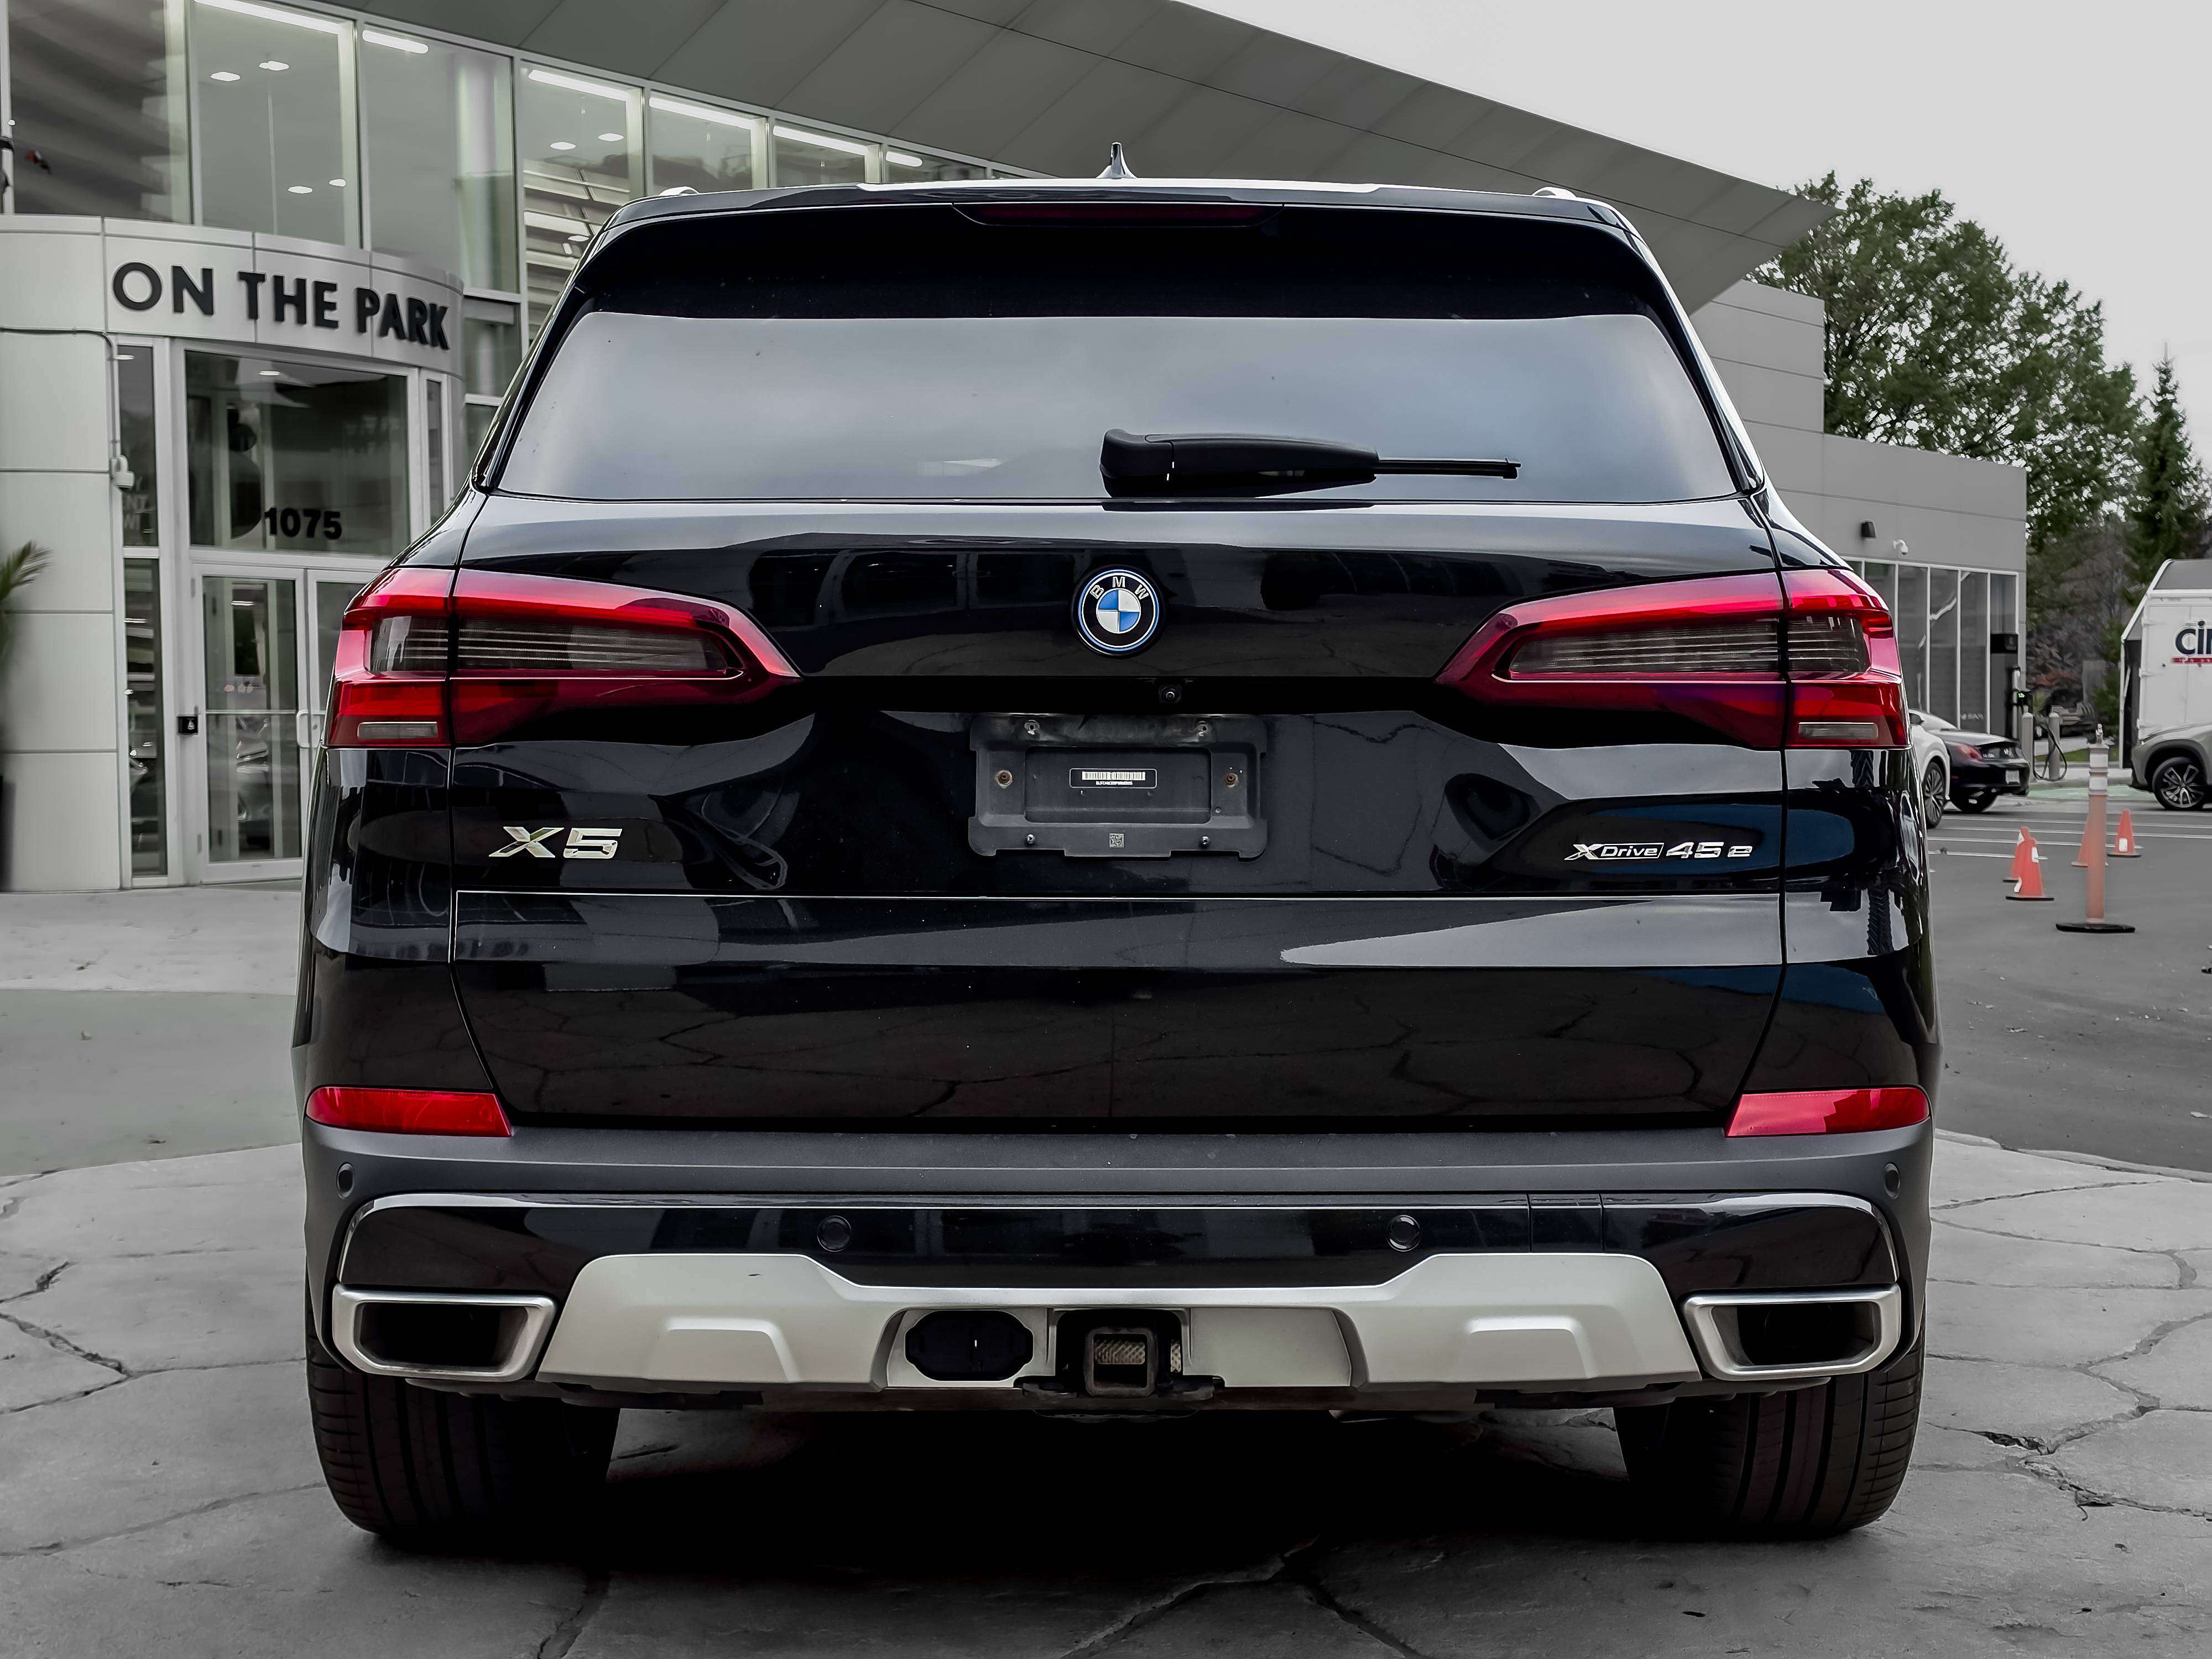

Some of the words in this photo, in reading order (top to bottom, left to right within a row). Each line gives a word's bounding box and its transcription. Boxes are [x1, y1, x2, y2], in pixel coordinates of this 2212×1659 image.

[113, 262, 214, 316] ON
[237, 271, 339, 329] THE
[354, 286, 450, 351] PARK
[264, 507, 342, 541] 1075
[1089, 576, 1149, 600] BMW
[488, 826, 623, 859] X5
